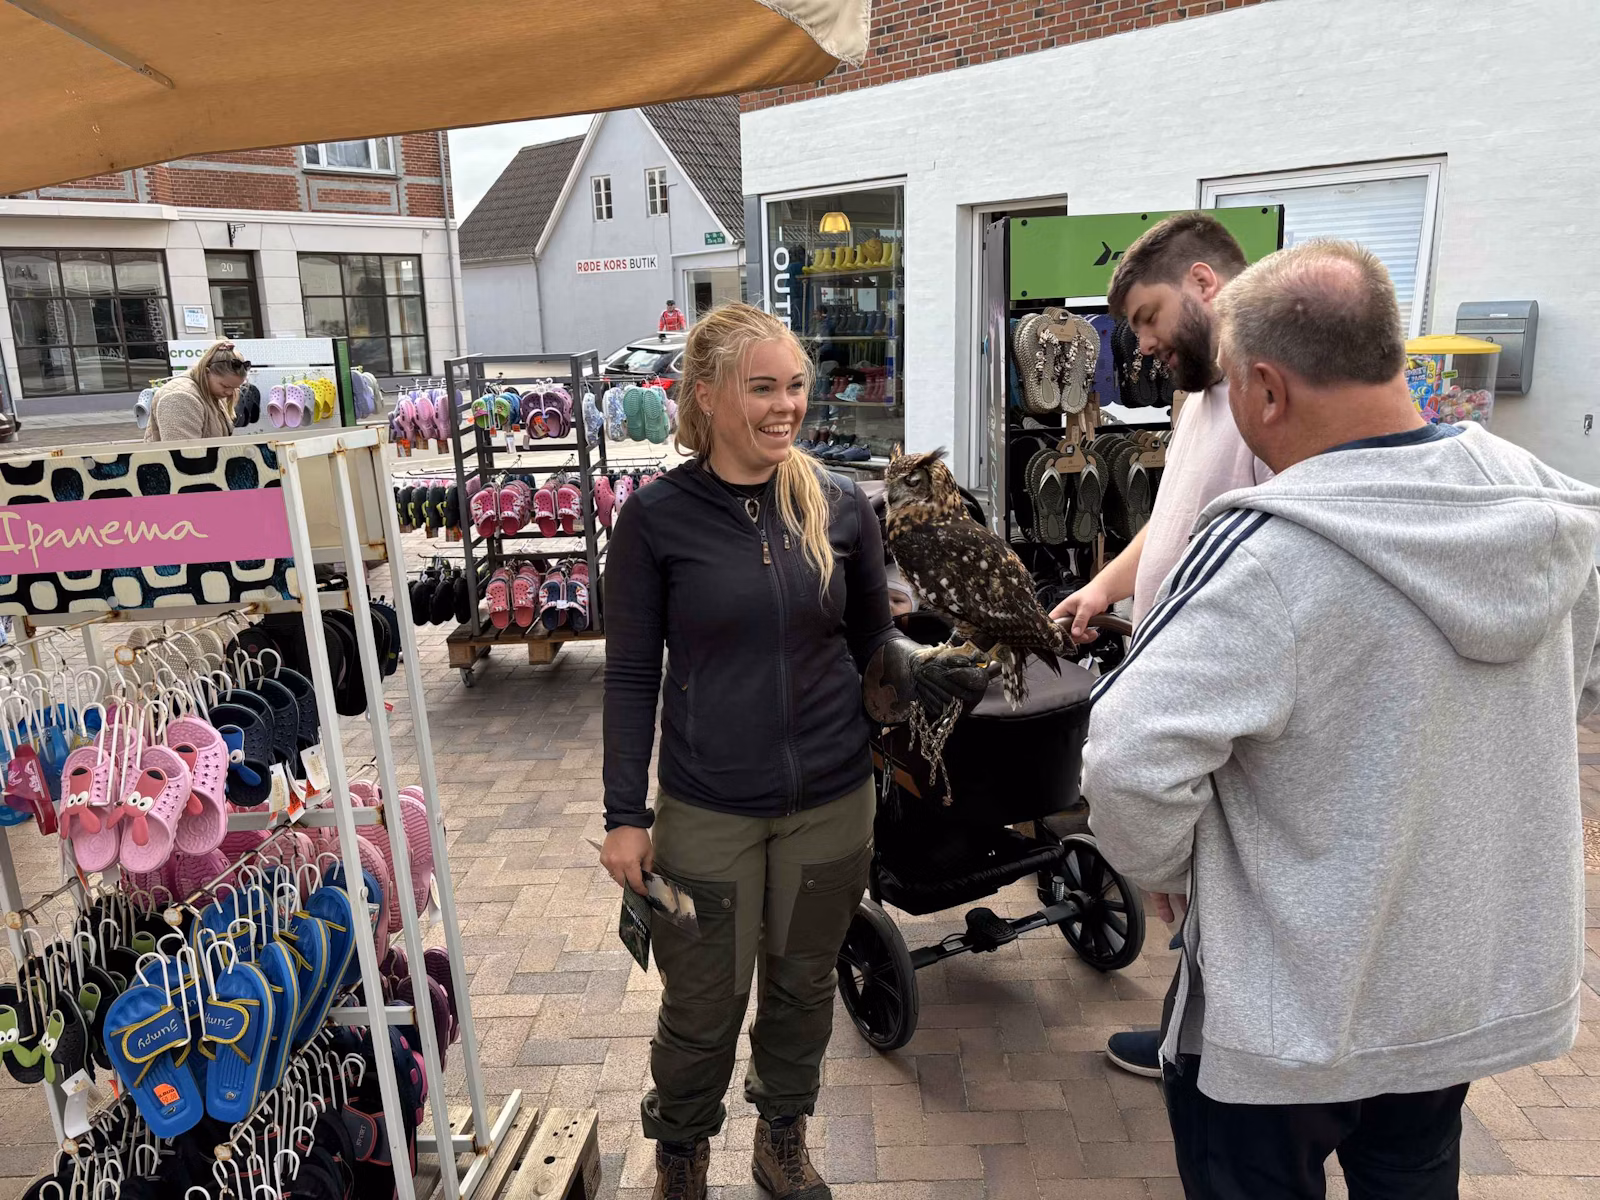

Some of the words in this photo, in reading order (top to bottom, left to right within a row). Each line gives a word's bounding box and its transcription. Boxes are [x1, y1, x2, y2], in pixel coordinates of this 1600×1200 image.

[220, 262, 233, 272] 20
[577, 261, 601, 272] RØDE
[603, 259, 627, 271] KORS
[629, 256, 657, 269] BUTIK
[0, 511, 209, 568] Ipanema
[137, 1018, 179, 1050] Jumpy
